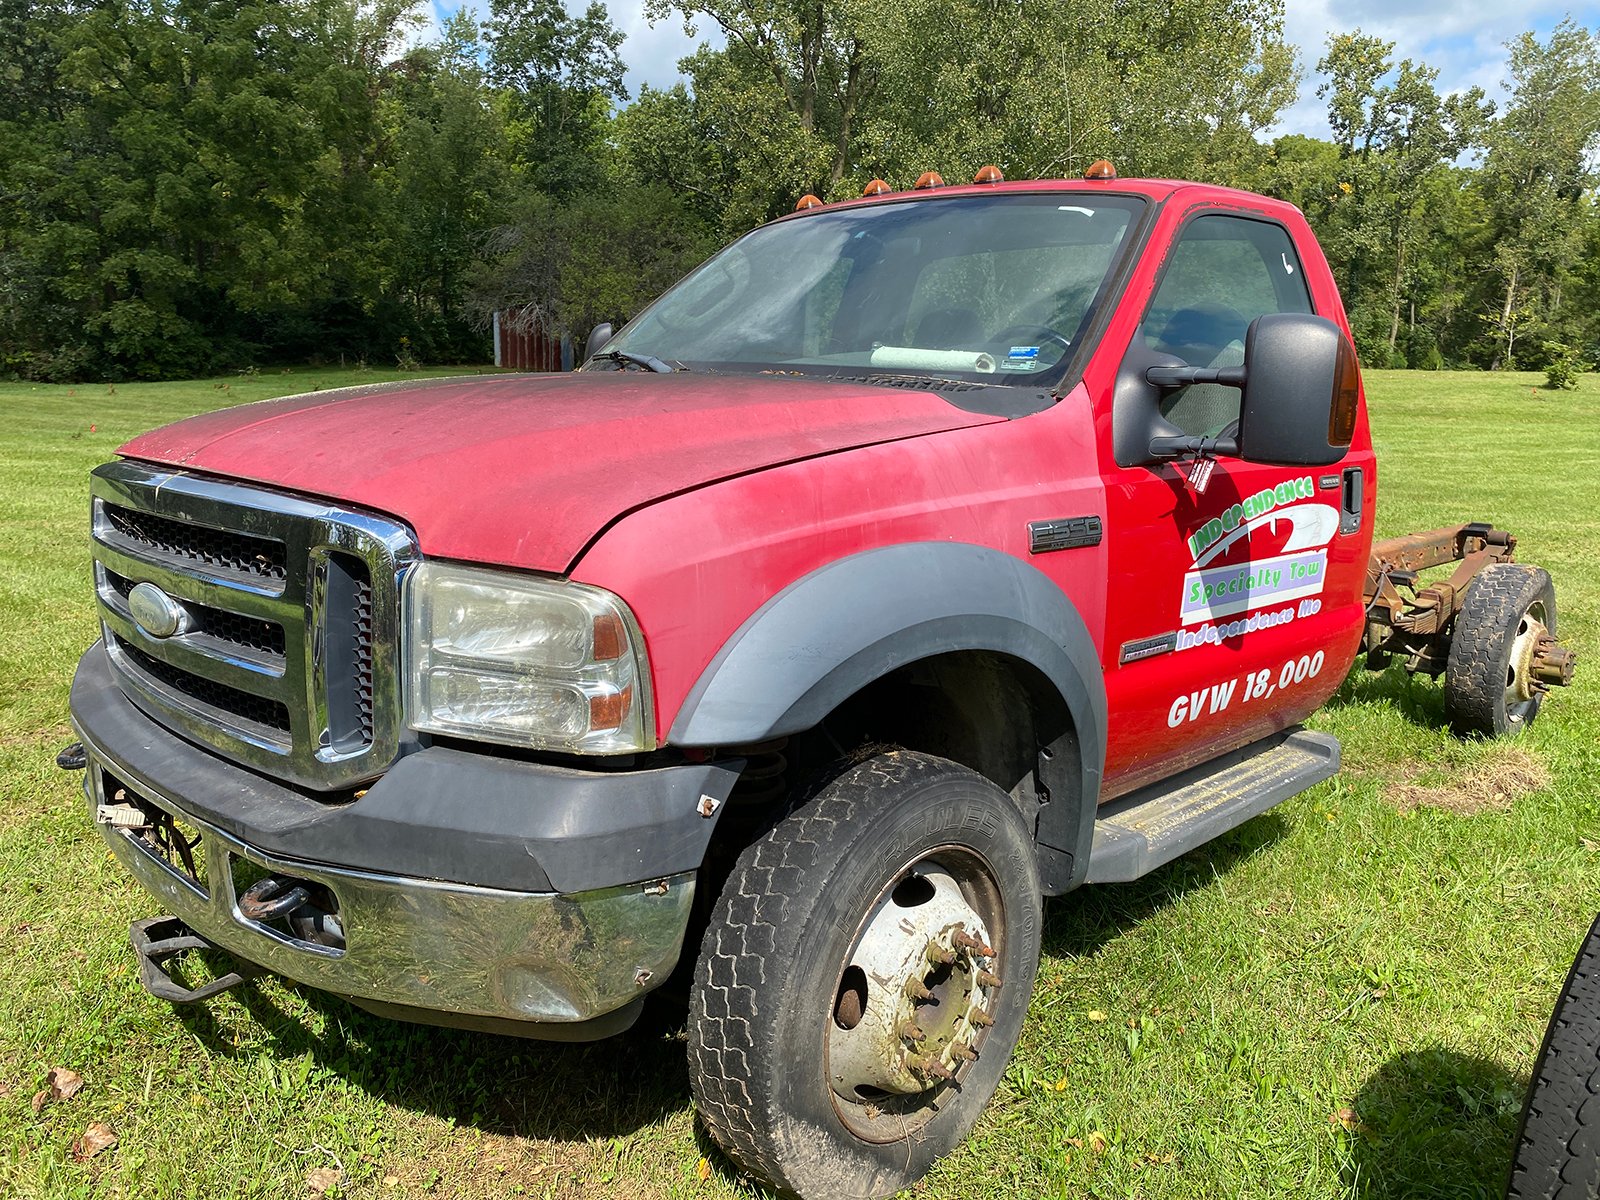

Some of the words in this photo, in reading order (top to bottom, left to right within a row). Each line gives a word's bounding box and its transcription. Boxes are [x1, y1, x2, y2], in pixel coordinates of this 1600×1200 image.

[1188, 476, 1315, 561] INDEPENDENCE
[1189, 569, 1282, 605] Specialty
[1289, 560, 1321, 580] Tow
[1175, 607, 1294, 651] Independence
[1297, 599, 1322, 618] Mo
[1167, 678, 1237, 728] GVW
[1243, 650, 1325, 702] 18,000
[836, 805, 1000, 937] HERCULES
